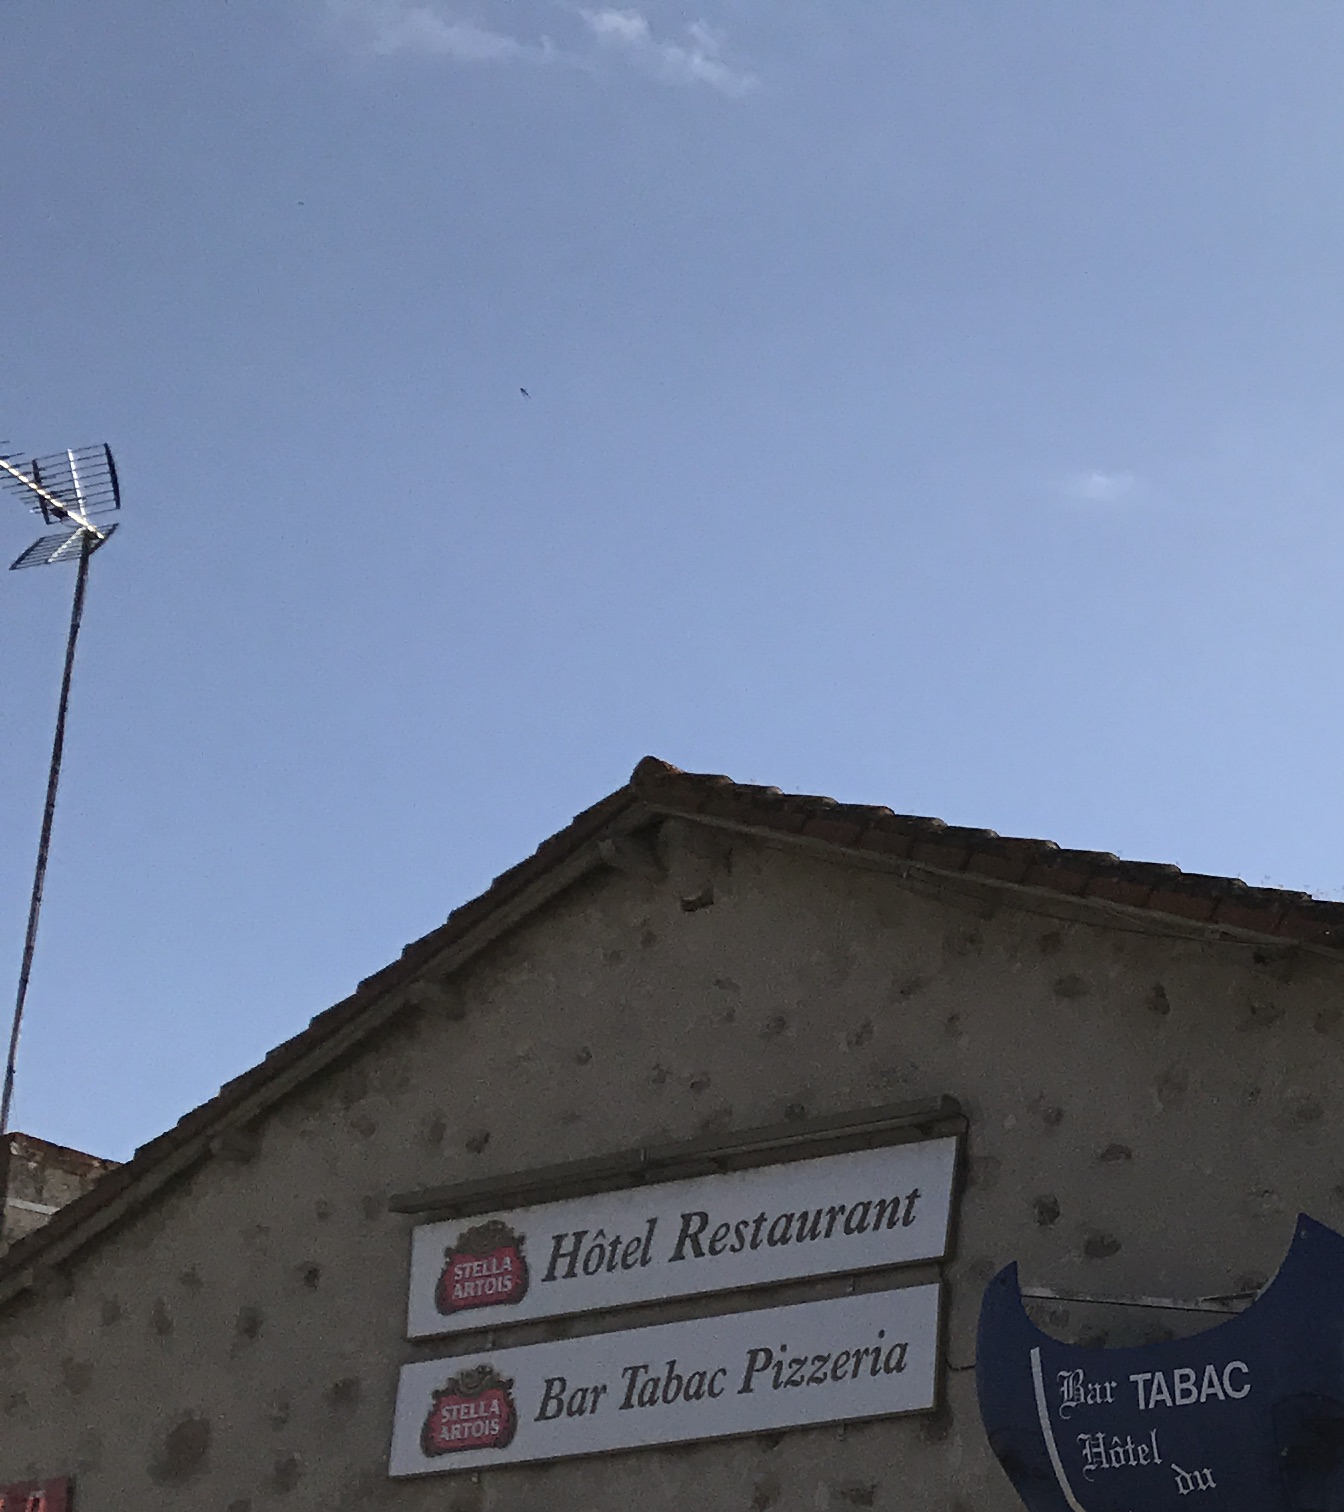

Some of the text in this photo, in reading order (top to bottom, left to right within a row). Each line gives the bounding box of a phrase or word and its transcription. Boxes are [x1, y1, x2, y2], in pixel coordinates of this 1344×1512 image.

[541, 1187, 921, 1283] Hôtel Restaurant
[452, 1275, 513, 1299] ARTOIS
[453, 1258, 512, 1283] STELLA
[534, 1329, 909, 1422] Bar Tabac Pizzeria
[1056, 1360, 1252, 1420] Bar TABAC
[440, 1399, 499, 1424] STELLA
[438, 1417, 500, 1441] ARTOIS
[1076, 1429, 1163, 1482] Hôtel
[1170, 1462, 1217, 1496] du
